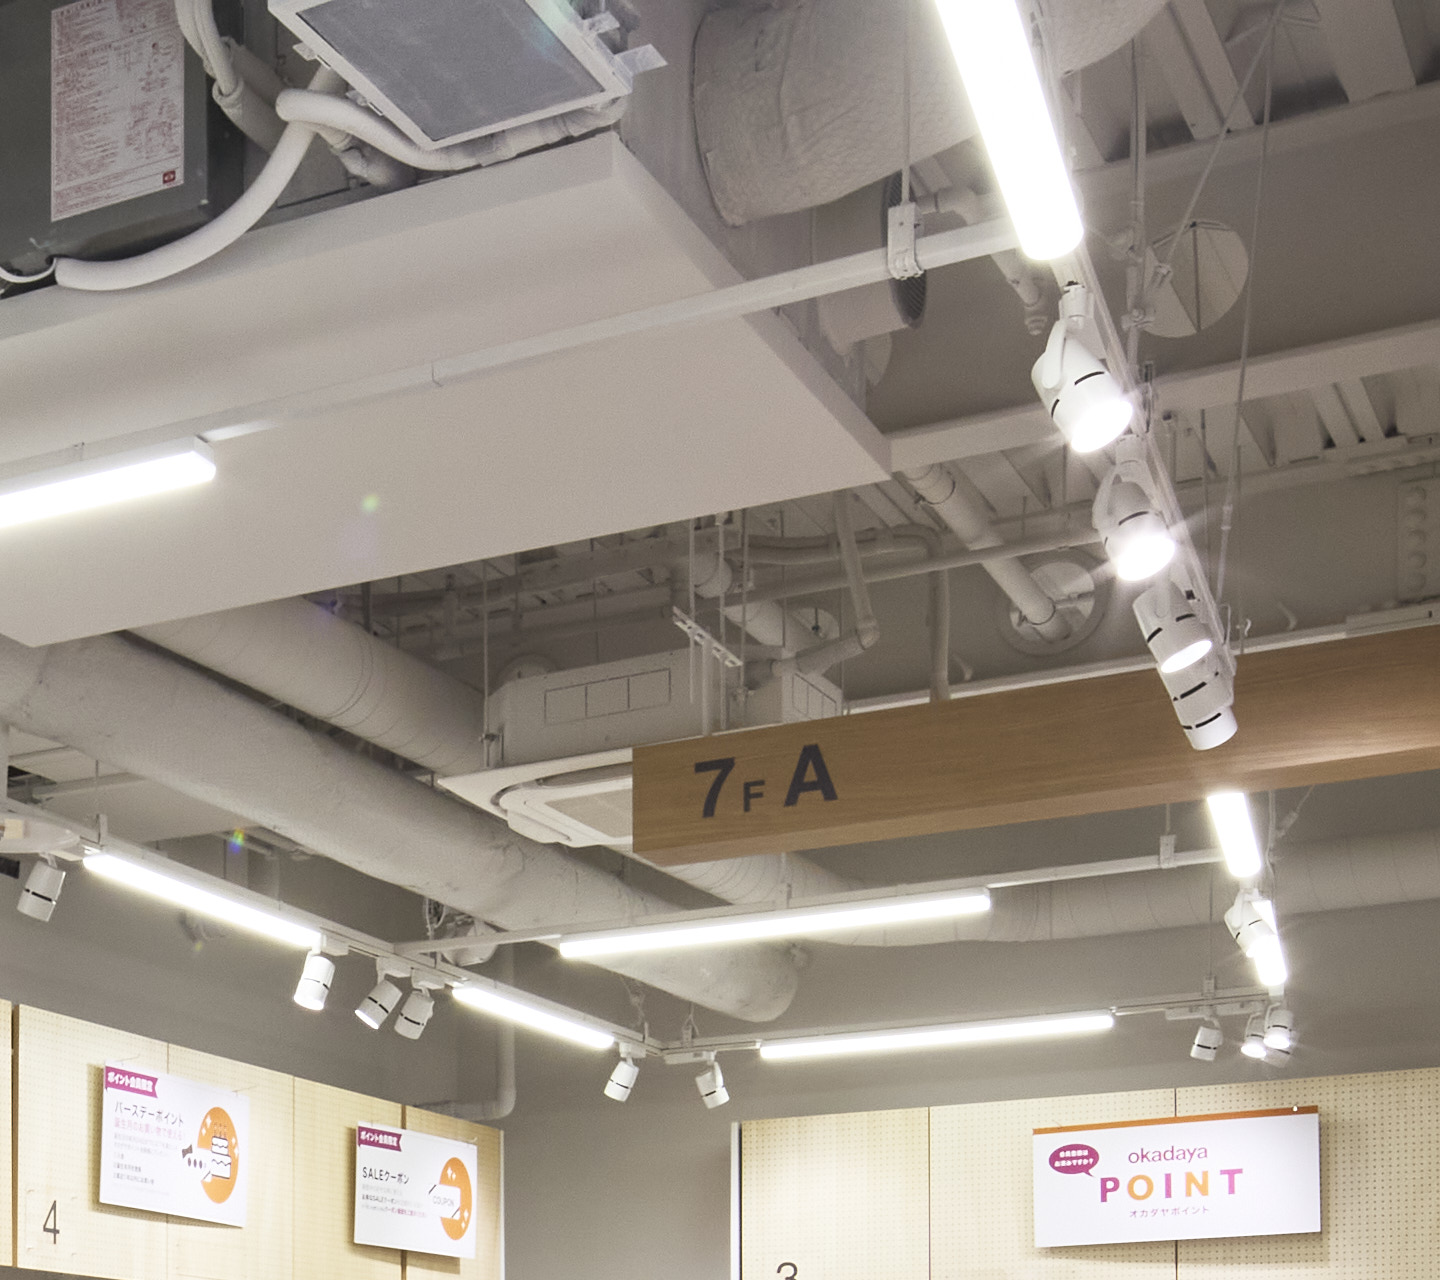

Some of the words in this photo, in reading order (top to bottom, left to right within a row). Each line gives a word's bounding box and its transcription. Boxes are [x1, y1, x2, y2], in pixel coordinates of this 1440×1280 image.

[783, 743, 838, 808] A
[114, 1100, 185, 1128] バースデーポイント
[1128, 1145, 1209, 1165] okadaya
[1099, 1167, 1245, 1204] POINT
[42, 1199, 61, 1246] 4
[1128, 1205, 1210, 1219] オカダヤポイント
